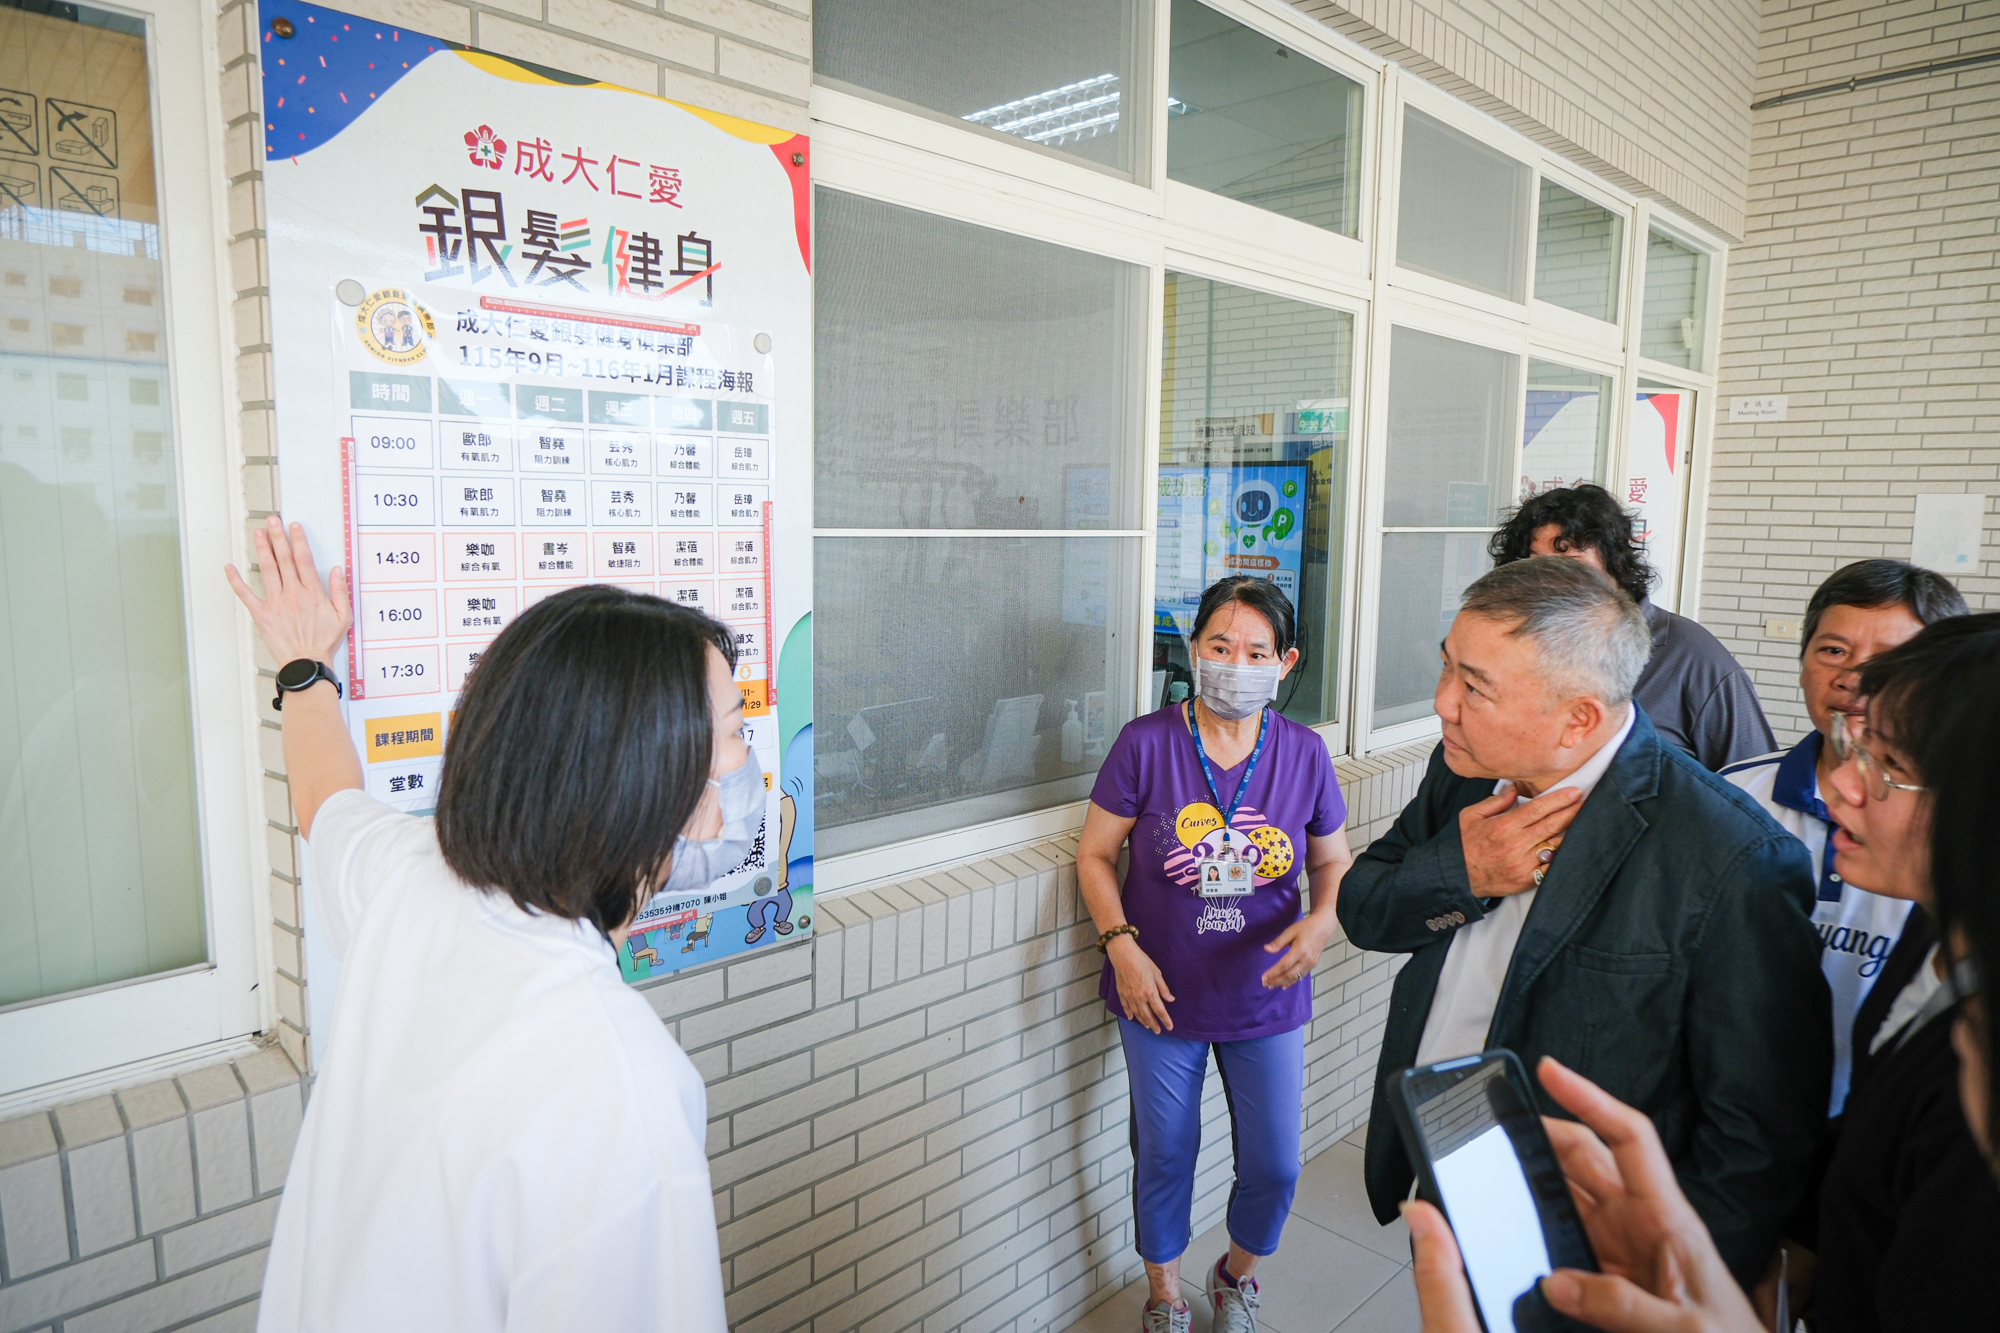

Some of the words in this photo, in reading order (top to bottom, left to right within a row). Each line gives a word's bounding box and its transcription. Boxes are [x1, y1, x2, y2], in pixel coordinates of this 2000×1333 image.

[514, 137, 684, 209] 成大仁愛
[415, 183, 722, 307] 銀髮健身
[371, 383, 410, 402] 時間
[459, 389, 491, 407] 週一
[534, 395, 566, 412] 週二
[605, 400, 633, 418] 週三
[670, 406, 697, 421] 週四
[731, 410, 755, 425] 週五
[370, 436, 416, 450] 09:00
[462, 432, 492, 447] 歐郎
[539, 436, 565, 450] 智堯
[609, 440, 633, 454] 芸秀
[674, 443, 697, 456] 乃馨
[460, 452, 500, 463] 有氧肌力
[534, 454, 571, 465] 阻力訓練
[605, 457, 638, 468] 核心肌力
[670, 461, 701, 470] 綜合體能
[731, 462, 759, 472] 綜合肌力
[464, 487, 494, 501] 歐郎
[541, 489, 567, 503] 智堯
[610, 490, 634, 504] 芸秀
[674, 492, 697, 505] 乃馨
[1629, 477, 1647, 504] 愛
[373, 493, 419, 507] 10:30
[460, 507, 499, 517] 有氧肌力
[536, 507, 572, 517] 阻力訓練
[608, 508, 641, 518] 核心肌力
[670, 509, 701, 518] 綜合體能
[731, 509, 759, 518] 綜合肌力
[1278, 514, 1287, 527] P
[466, 543, 495, 557] 樂咖
[612, 541, 636, 554] 智堯
[376, 551, 420, 564] 14:30
[460, 562, 500, 572] 綜合有氧
[538, 561, 574, 571] 綜合體能
[608, 559, 641, 568] 敏捷阻力
[674, 558, 704, 567] 綜合體能
[730, 556, 758, 565] 綜合肌力
[467, 598, 496, 611] 樂咖
[379, 608, 422, 622] 16:00
[462, 616, 502, 627] 綜合有氧
[731, 602, 759, 611] 綜合肌力
[381, 663, 424, 679] 17:30
[375, 728, 434, 747] 課程期間
[389, 774, 424, 793] 堂數
[1181, 817, 1217, 830] Curves
[703, 892, 727, 905] 陳小姐
